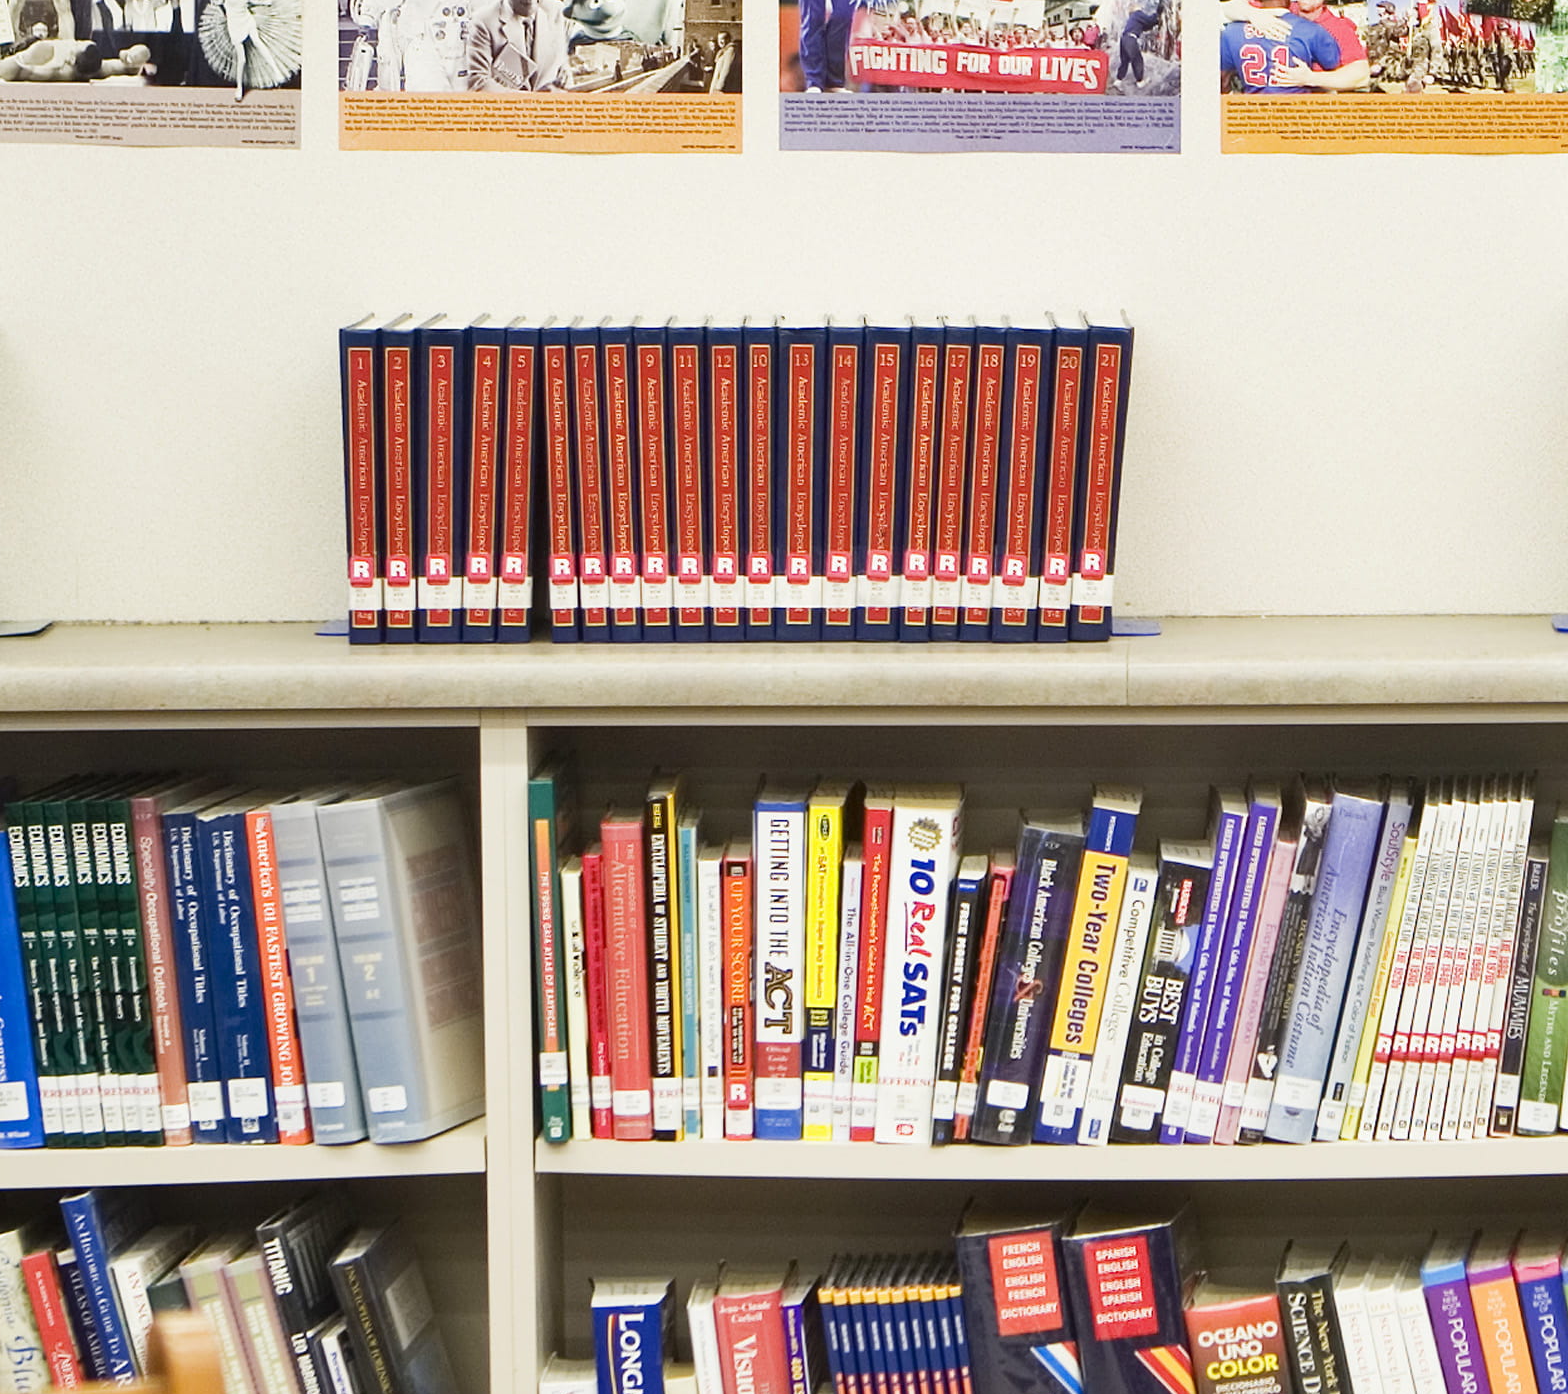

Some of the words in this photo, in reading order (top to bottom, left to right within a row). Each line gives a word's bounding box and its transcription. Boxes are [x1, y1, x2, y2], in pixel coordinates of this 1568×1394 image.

[850, 44, 947, 78] FIGHTING
[955, 51, 991, 74] FOR
[998, 54, 1033, 77] OUR
[1039, 57, 1101, 90] LIVES
[1240, 44, 1291, 87] 21
[111, 822, 131, 885] ECONOMICS
[770, 819, 790, 881] GETTING
[731, 881, 743, 900] UP
[908, 859, 936, 896] 10
[731, 904, 744, 951] YOUR
[769, 890, 789, 925] INTO
[1078, 863, 1117, 956] Two-Year
[769, 929, 789, 957] THE
[910, 901, 936, 958] Real
[731, 954, 744, 1004] SCORE
[764, 962, 794, 1035] ACT
[1065, 959, 1099, 1044] Colleges
[262, 1237, 294, 1296] TITANIC
[1003, 1242, 1041, 1256] FRENCH
[1003, 1255, 1043, 1269] ENGLISH
[1005, 1273, 1046, 1287] ENGLISH
[1008, 1286, 1046, 1301] FRENCH
[1001, 1302, 1058, 1320] DICTIONARY
[1198, 1321, 1278, 1348] OCEANO
[1218, 1340, 1263, 1361] UNO
[1206, 1354, 1279, 1381] COLOR
[1448, 1317, 1477, 1394] POPULAR
